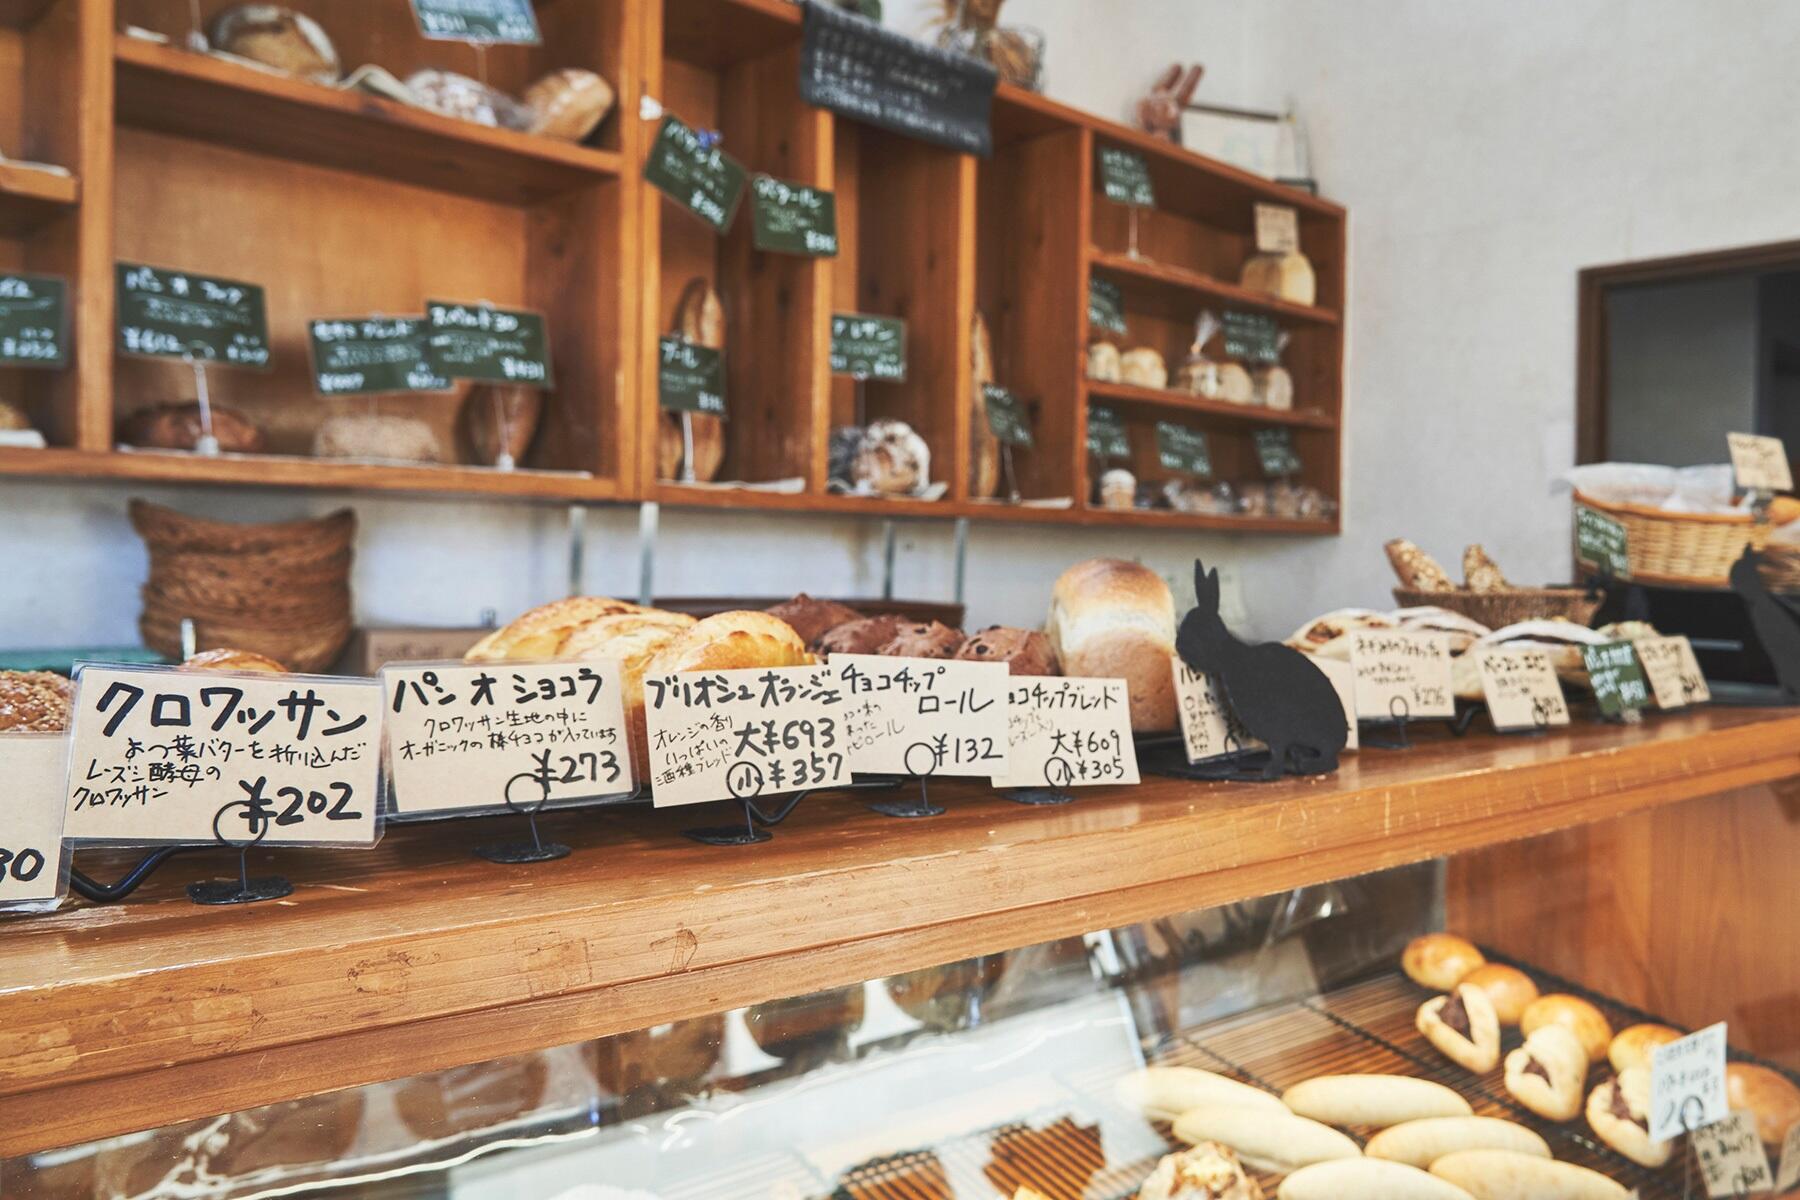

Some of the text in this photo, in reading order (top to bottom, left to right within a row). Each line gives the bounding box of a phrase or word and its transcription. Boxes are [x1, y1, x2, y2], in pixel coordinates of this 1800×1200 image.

[392, 668, 604, 714] パン オ ショコラ
[840, 662, 946, 694] チョコチップ
[96, 680, 368, 740] クロワッサン
[918, 687, 995, 715] ロール
[423, 708, 588, 740] クロワッサン生地の中に
[653, 711, 734, 751] オレンジの香り
[124, 734, 367, 769] よつ葉バターを折り込んだ
[933, 733, 1004, 768] ¥132
[86, 758, 222, 789] レーズン酵母の
[531, 748, 622, 794] ¥273
[72, 785, 169, 812] クロワッサン
[238, 776, 363, 834] ¥202
